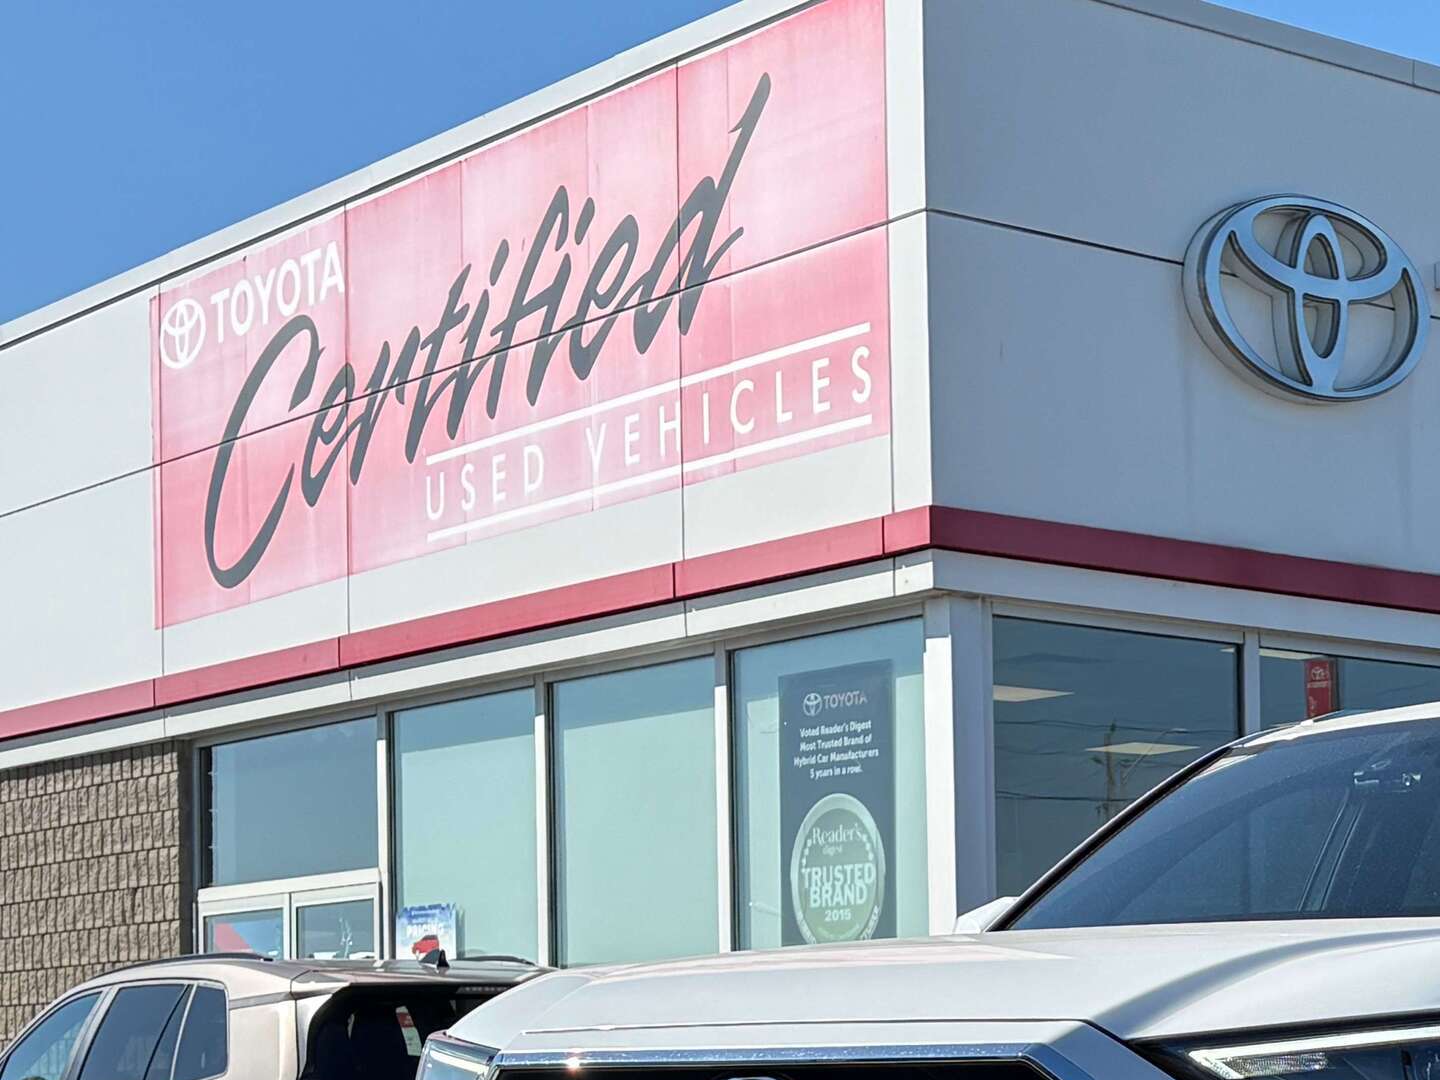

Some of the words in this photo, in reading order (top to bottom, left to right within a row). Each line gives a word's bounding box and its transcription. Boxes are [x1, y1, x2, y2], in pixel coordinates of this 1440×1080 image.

[211, 241, 345, 343] TOYOTA
[204, 72, 772, 588] Certified
[425, 444, 545, 520] USED
[585, 345, 873, 473] VEHICLES
[823, 690, 868, 709] TOYOTA
[800, 726, 819, 738] Voted
[850, 720, 871, 733] Digest
[817, 737, 842, 749] Trusted
[844, 734, 863, 747] Brand
[817, 753, 829, 764] Car
[812, 822, 863, 845] Reader's
[801, 863, 875, 888] TRUSTED
[810, 882, 868, 908] BRAND
[824, 909, 852, 921] 2015
